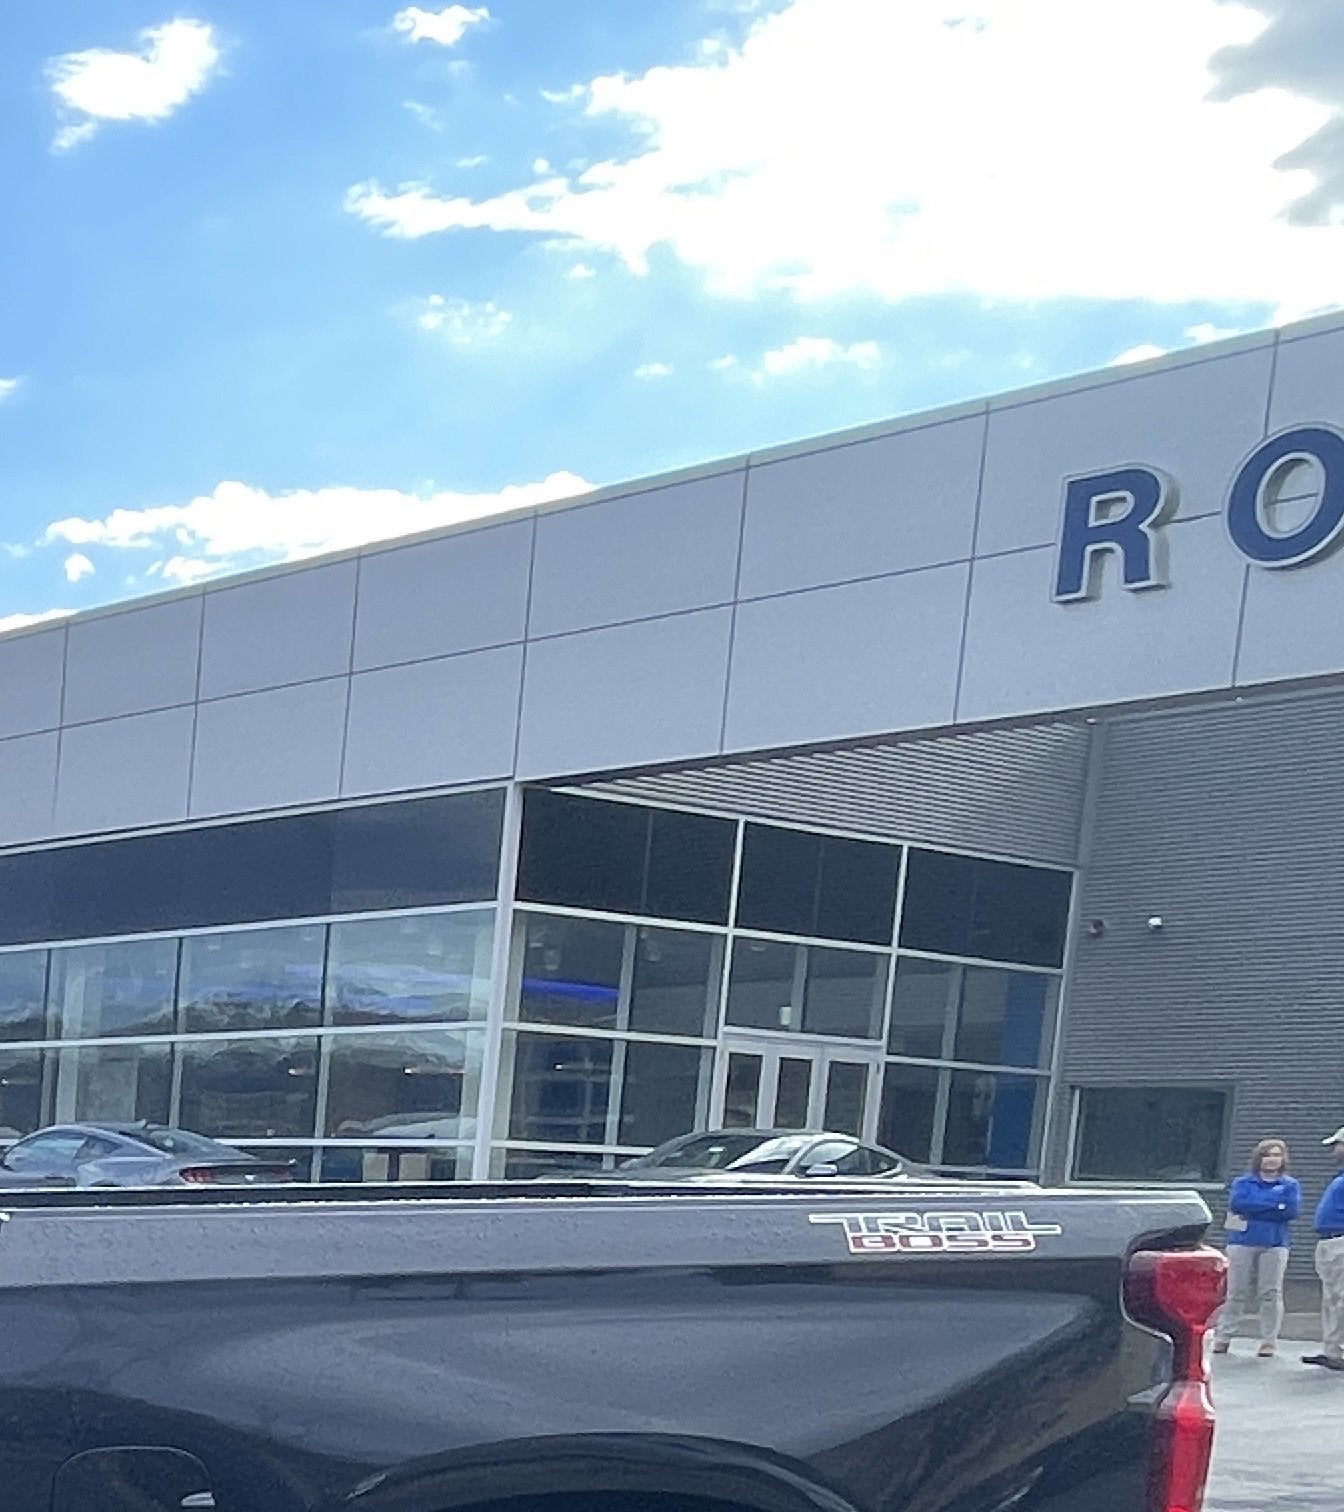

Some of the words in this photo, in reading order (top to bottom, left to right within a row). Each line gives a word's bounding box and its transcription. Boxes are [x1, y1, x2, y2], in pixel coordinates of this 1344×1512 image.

[1052, 423, 1344, 602] RO
[808, 1211, 1062, 1235] TRAIL
[848, 1233, 1036, 1254] BOSS
